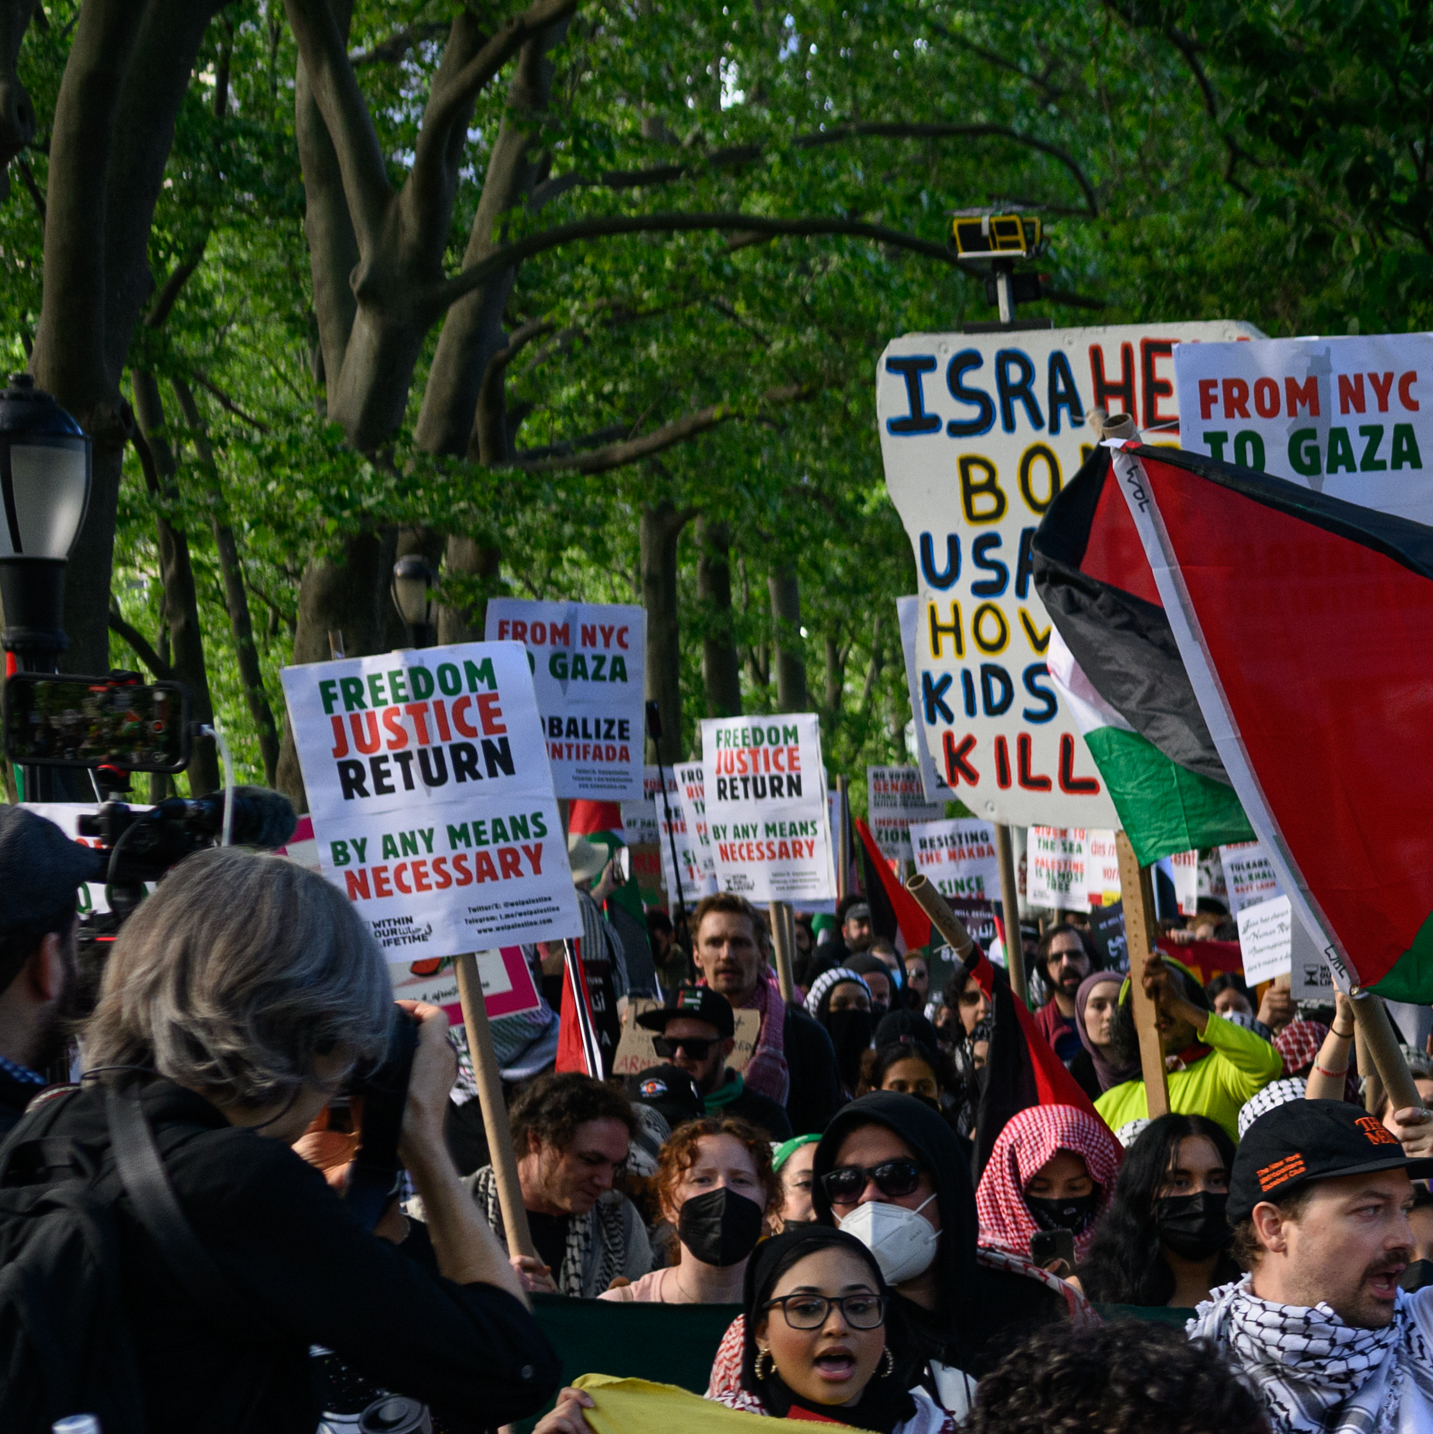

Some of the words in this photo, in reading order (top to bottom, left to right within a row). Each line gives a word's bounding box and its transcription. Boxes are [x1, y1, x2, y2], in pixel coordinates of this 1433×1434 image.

[1198, 375, 1321, 420] FROM
[1337, 370, 1420, 415] NYC
[1202, 429, 1266, 473] TO
[1287, 423, 1423, 476] GAZA
[498, 619, 570, 647] FROM
[580, 623, 629, 650] NYC
[548, 651, 628, 683] GAZA
[318, 657, 498, 715] FREEDOM
[921, 662, 1058, 725] KIDS
[331, 692, 508, 760] JUSTICE
[541, 715, 630, 742] BALIZE
[715, 724, 799, 749] FREEDOM
[336, 736, 516, 801] RETURN
[715, 745, 802, 776] JUSTICE
[680, 768, 704, 784] FRO
[717, 775, 802, 801] RETURN
[330, 837, 367, 867] BY
[382, 827, 435, 860] ANY
[446, 811, 548, 850] MEANS
[712, 824, 727, 841] BY
[733, 822, 758, 840] ANY
[764, 820, 818, 838] MEANS
[876, 829, 911, 843] ZION
[919, 829, 990, 850] RESISTING
[718, 839, 815, 862] NECESSARY
[917, 848, 942, 866] THE
[1037, 838, 1055, 851] THE
[344, 842, 544, 901] NECESSARY
[1034, 857, 1085, 873] PALESTINE
[1045, 868, 1084, 883] ALMOST
[938, 875, 984, 896] SINCE
[371, 915, 414, 929] WITHIN
[373, 927, 398, 938] OUR
[382, 934, 429, 947] IFETIME
